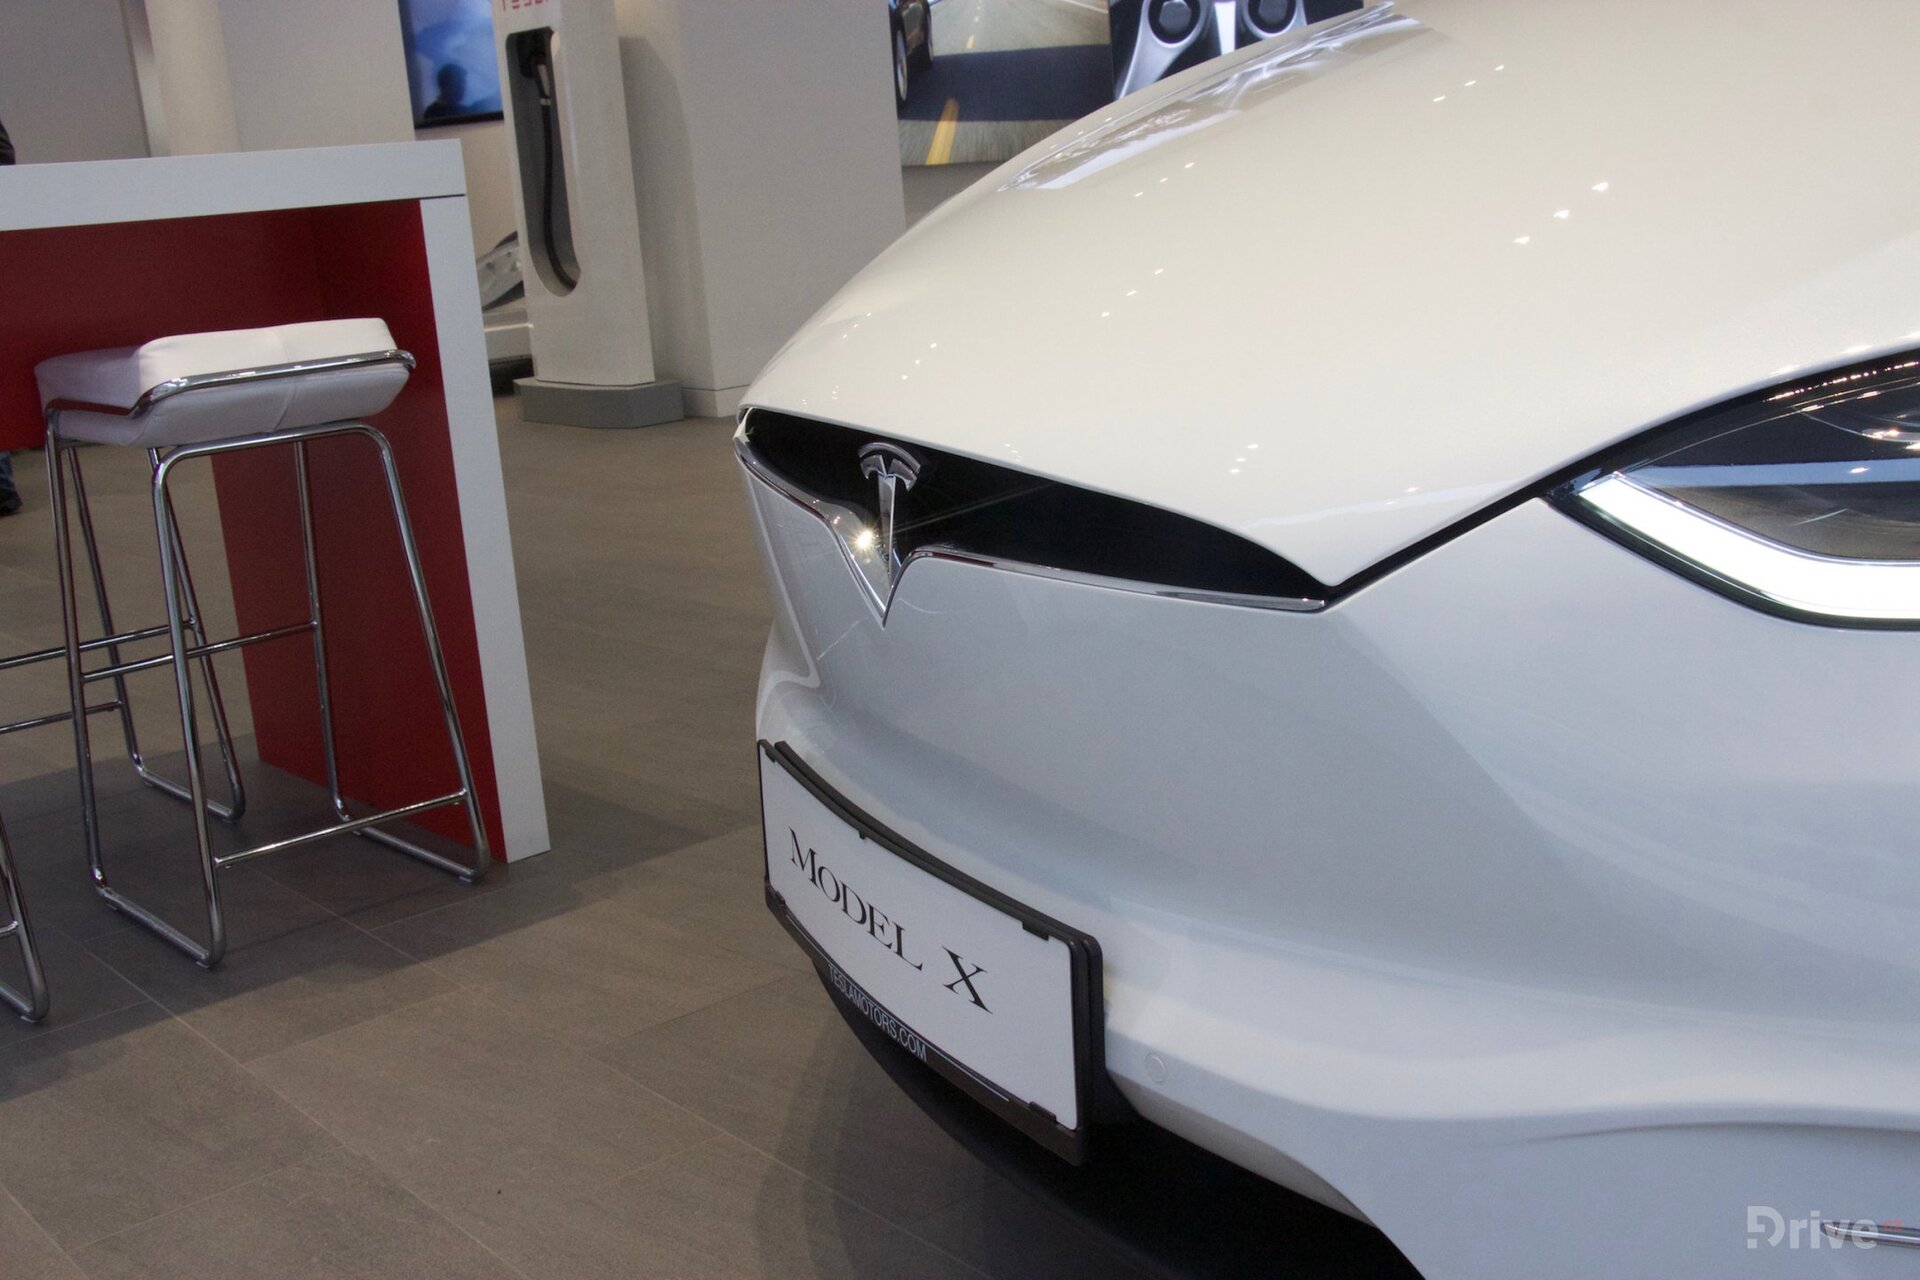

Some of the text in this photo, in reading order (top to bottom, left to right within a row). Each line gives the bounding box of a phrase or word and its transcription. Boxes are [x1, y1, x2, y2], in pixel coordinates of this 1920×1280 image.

[789, 826, 993, 1014] MODEL X
[828, 963, 927, 1062] TESLAMOTORS.COM
